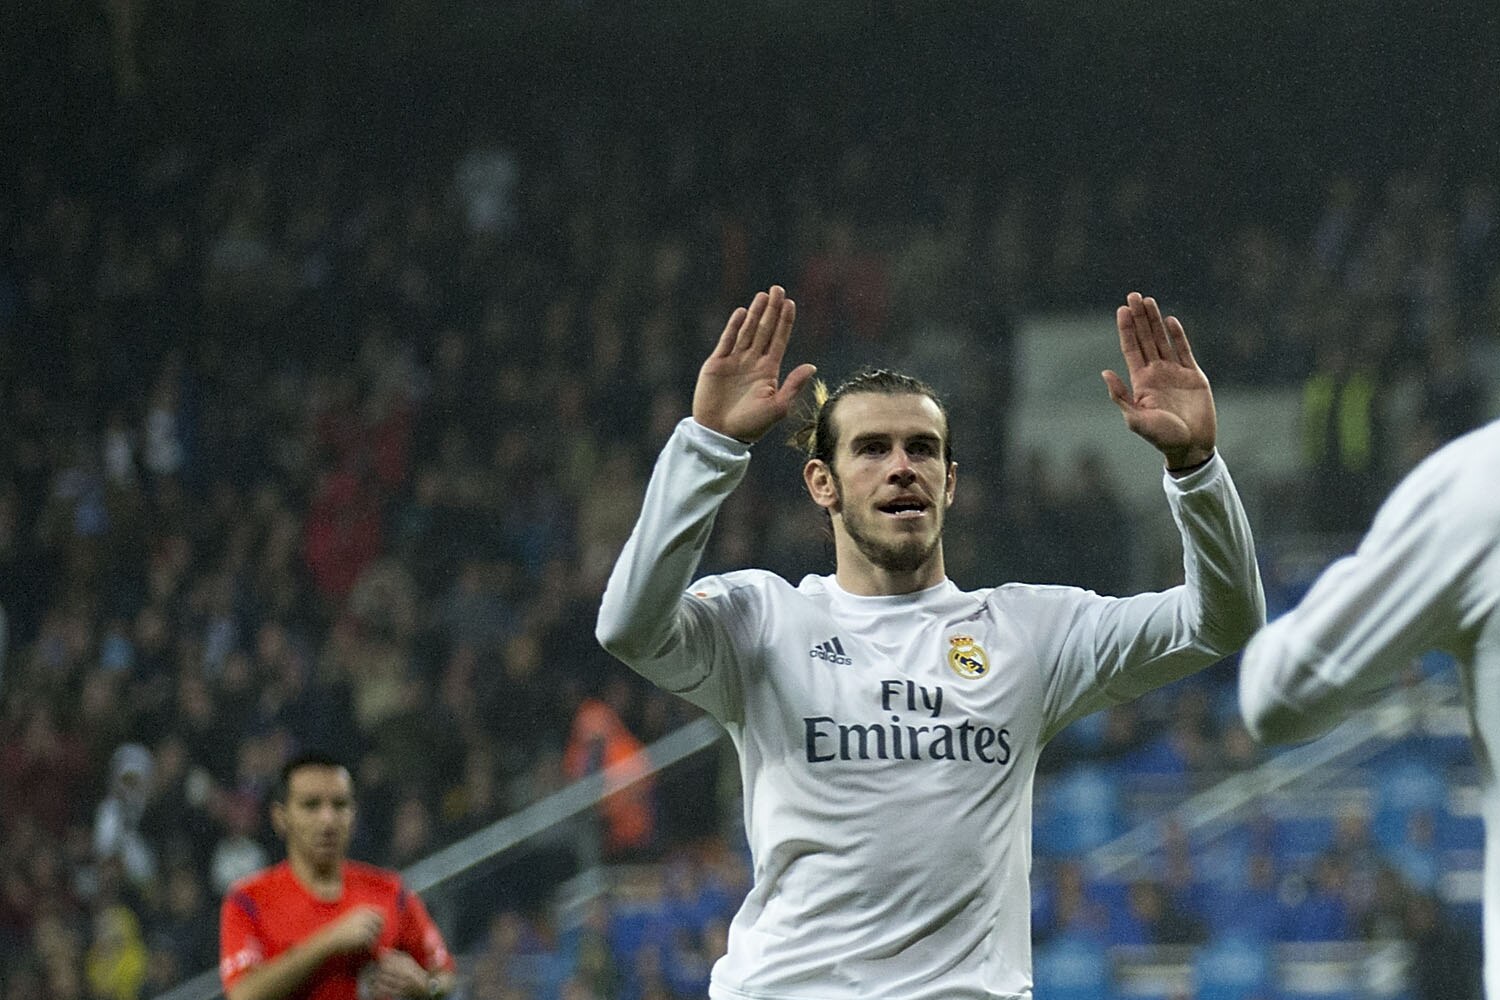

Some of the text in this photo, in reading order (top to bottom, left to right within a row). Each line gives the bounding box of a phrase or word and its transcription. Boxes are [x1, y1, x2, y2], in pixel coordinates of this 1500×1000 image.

[809, 650, 852, 665] adidas
[880, 679, 943, 717] Fly
[803, 715, 1010, 765] Emirates
